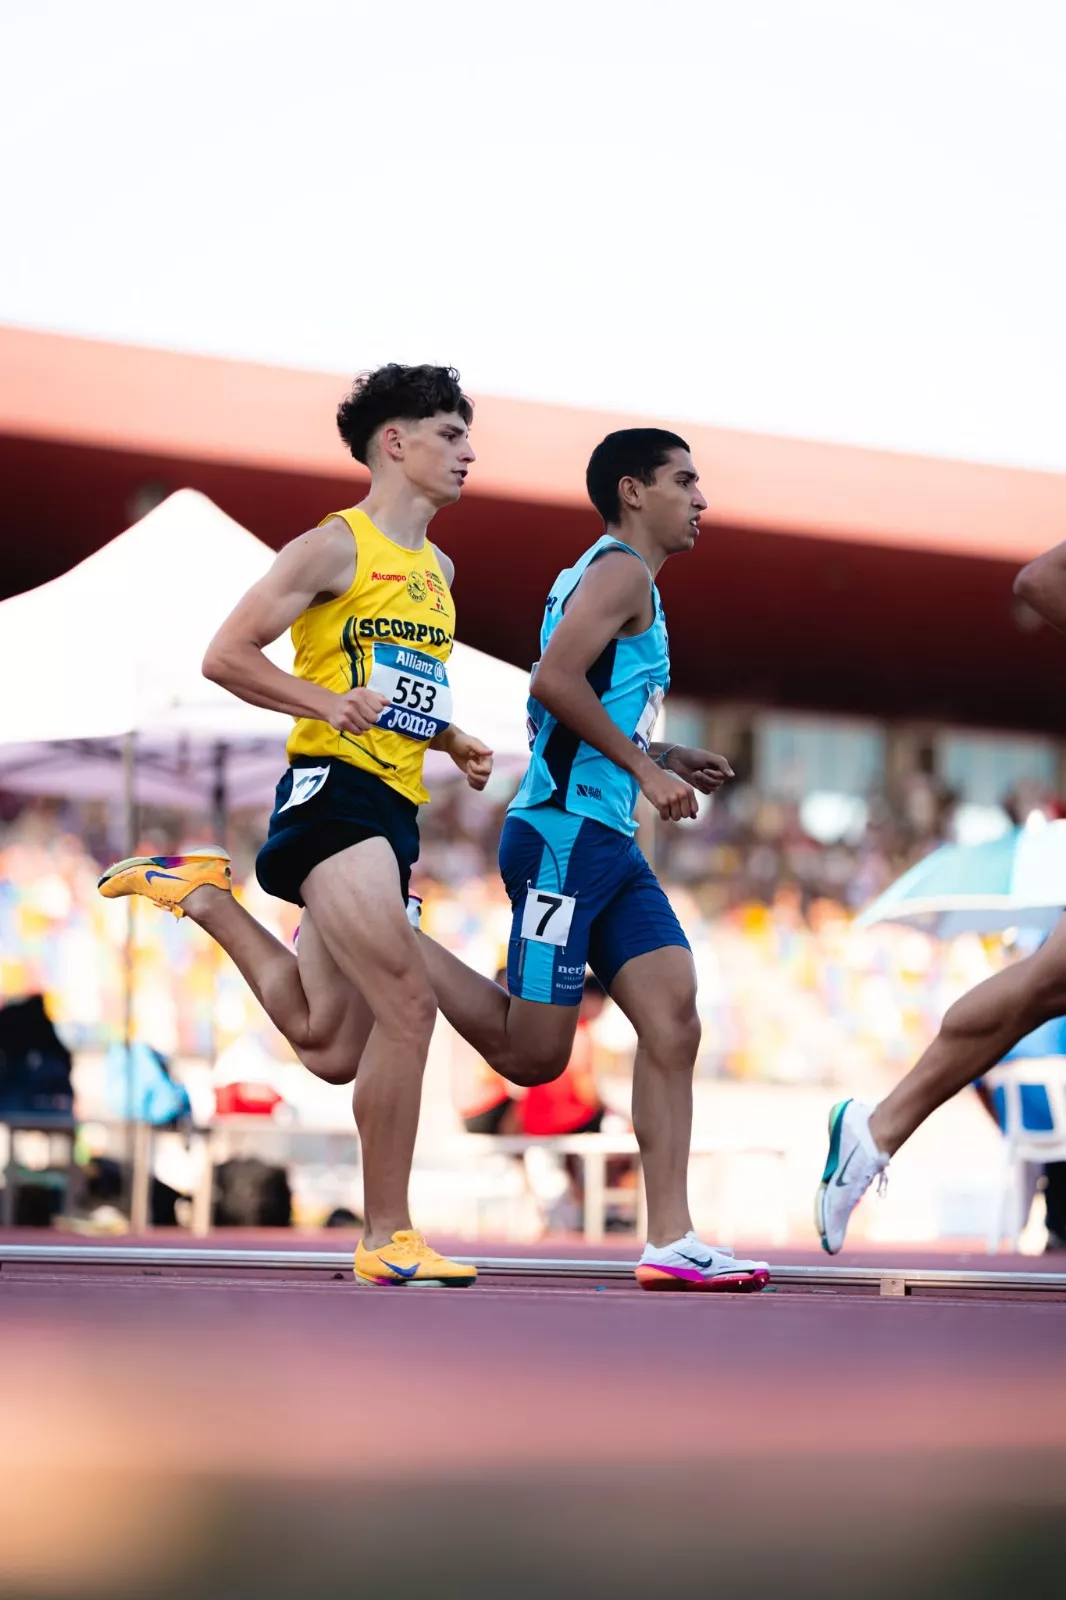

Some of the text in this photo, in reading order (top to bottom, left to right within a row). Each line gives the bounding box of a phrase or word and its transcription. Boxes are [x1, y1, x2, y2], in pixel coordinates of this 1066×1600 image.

[371, 571, 407, 582] Alcampo
[395, 650, 434, 675] Allianz
[392, 675, 437, 713] 553
[535, 893, 563, 937] 7
[557, 963, 586, 976] nerj
